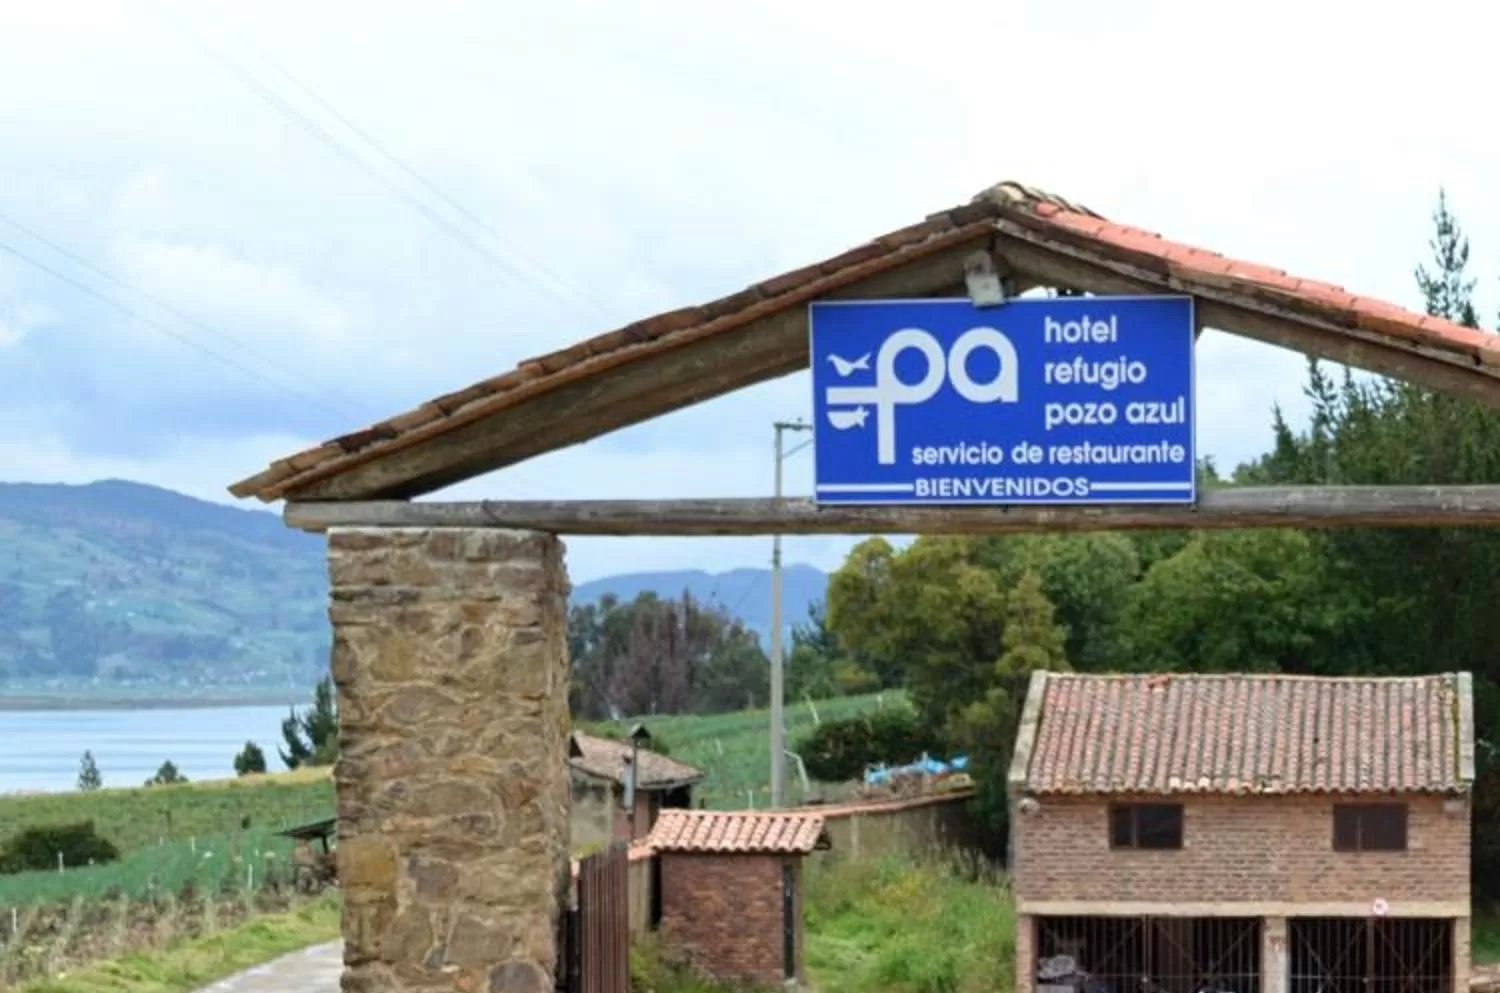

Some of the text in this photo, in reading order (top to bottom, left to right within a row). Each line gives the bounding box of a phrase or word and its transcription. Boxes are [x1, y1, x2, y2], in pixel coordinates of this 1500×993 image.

[1044, 315, 1117, 343] hotel
[1044, 356, 1147, 390] refugio
[1045, 396, 1185, 429] pozo azul
[912, 440, 1185, 464] servicio de restaurante
[915, 477, 1089, 496] BIENVENIDOS
